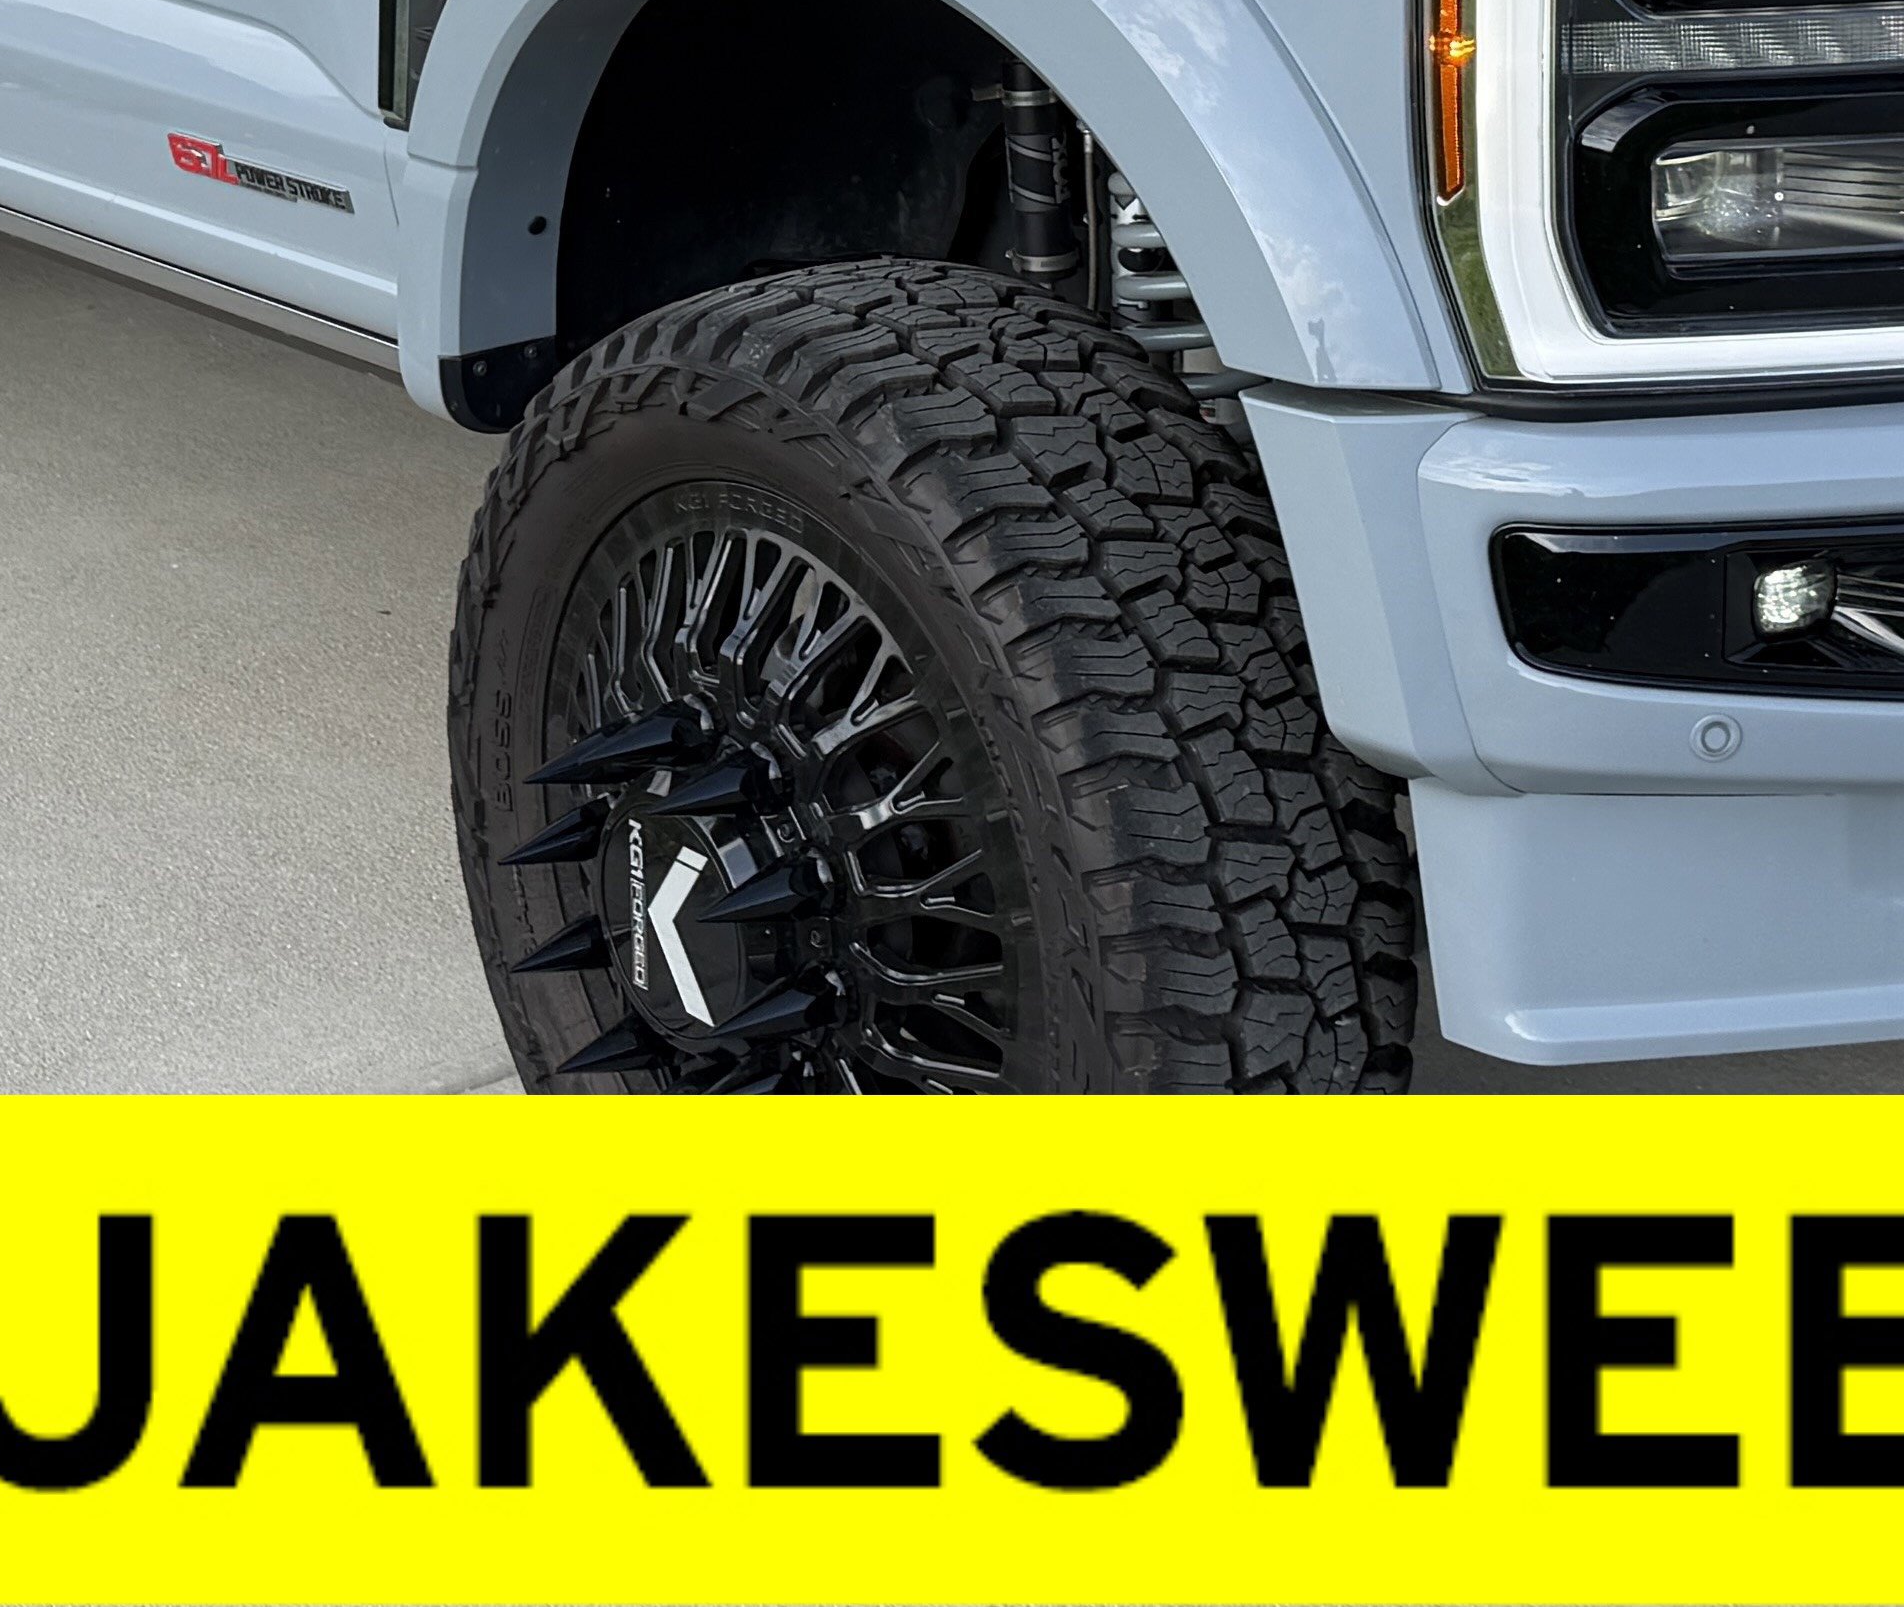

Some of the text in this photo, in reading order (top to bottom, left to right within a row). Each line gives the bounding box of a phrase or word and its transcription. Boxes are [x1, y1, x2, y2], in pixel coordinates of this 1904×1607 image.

[238, 162, 287, 192] POWER
[287, 177, 347, 210] STROKE
[489, 689, 514, 812] BOSS
